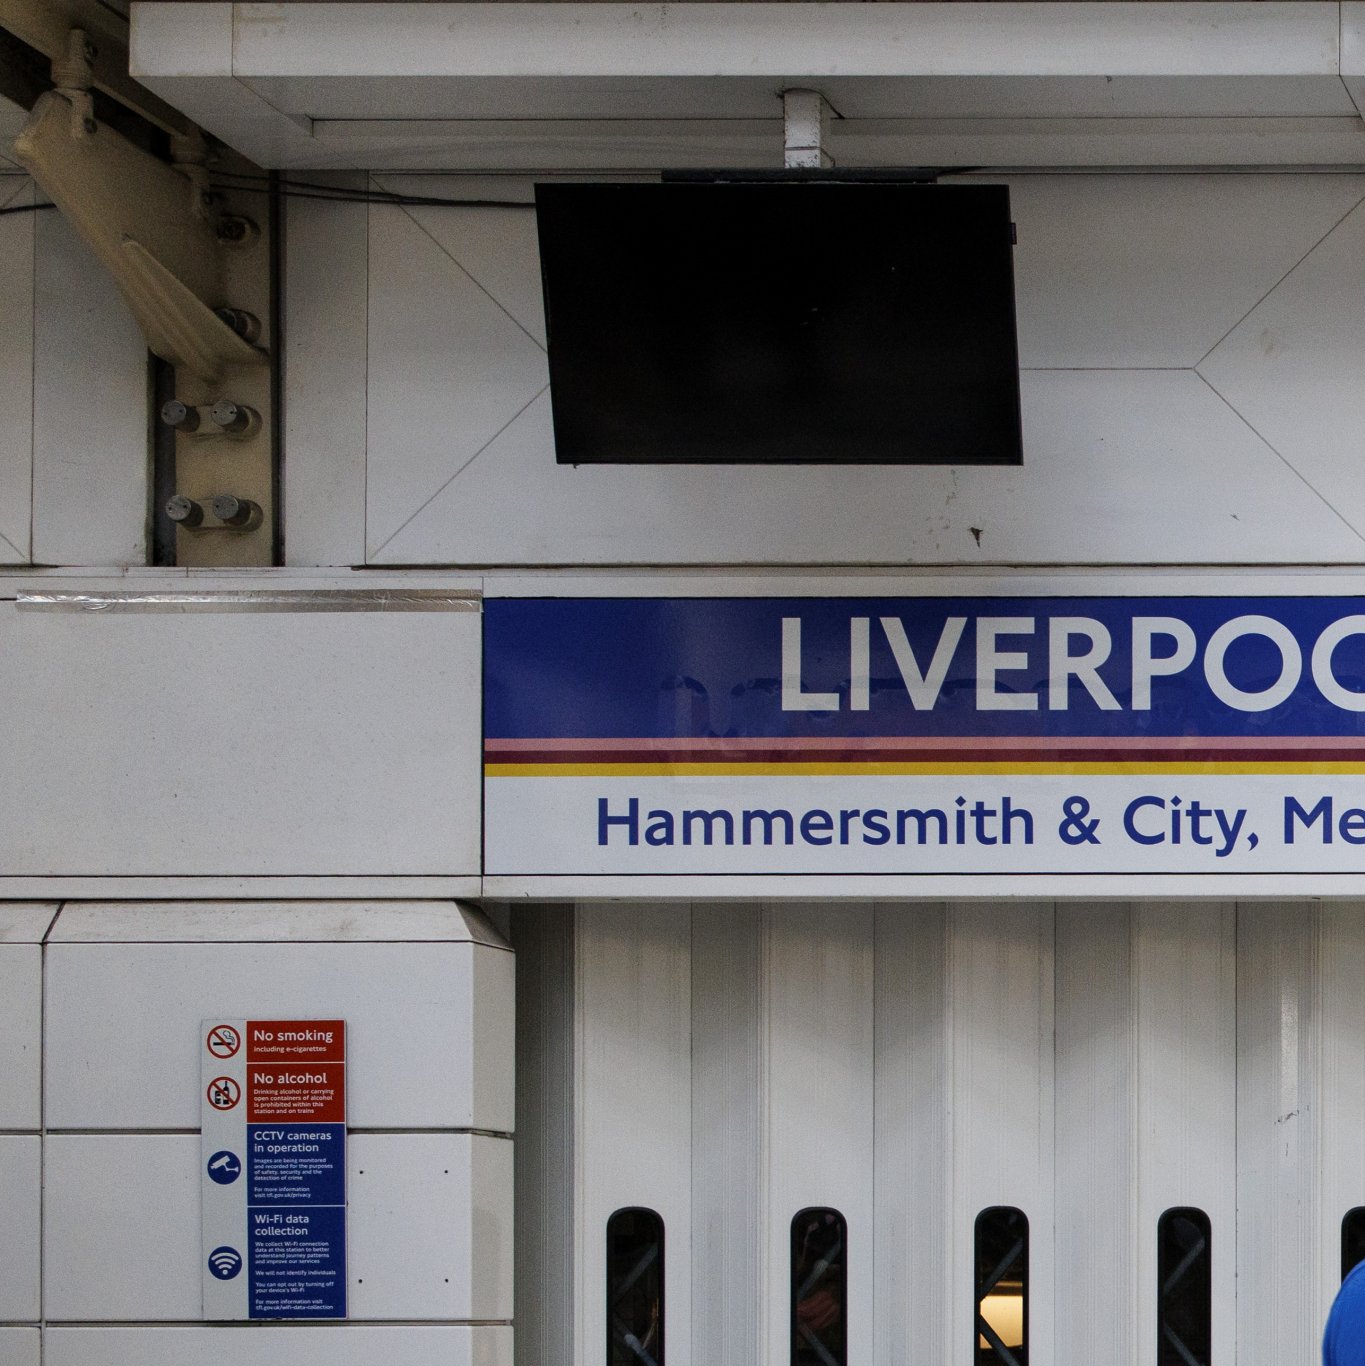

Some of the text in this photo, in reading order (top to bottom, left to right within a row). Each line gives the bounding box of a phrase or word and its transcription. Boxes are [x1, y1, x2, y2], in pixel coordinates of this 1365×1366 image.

[598, 796, 1033, 846] Hammersmith
[1059, 796, 1101, 845] &
[1124, 796, 1258, 857] City,
[254, 1030, 333, 1043] No smoking
[254, 1073, 327, 1084] No alcohol
[254, 1131, 284, 1140] CCTV
[254, 1143, 319, 1154] in operation
[255, 1215, 309, 1224] Wi-Fi data
[255, 1227, 308, 1235] collection
